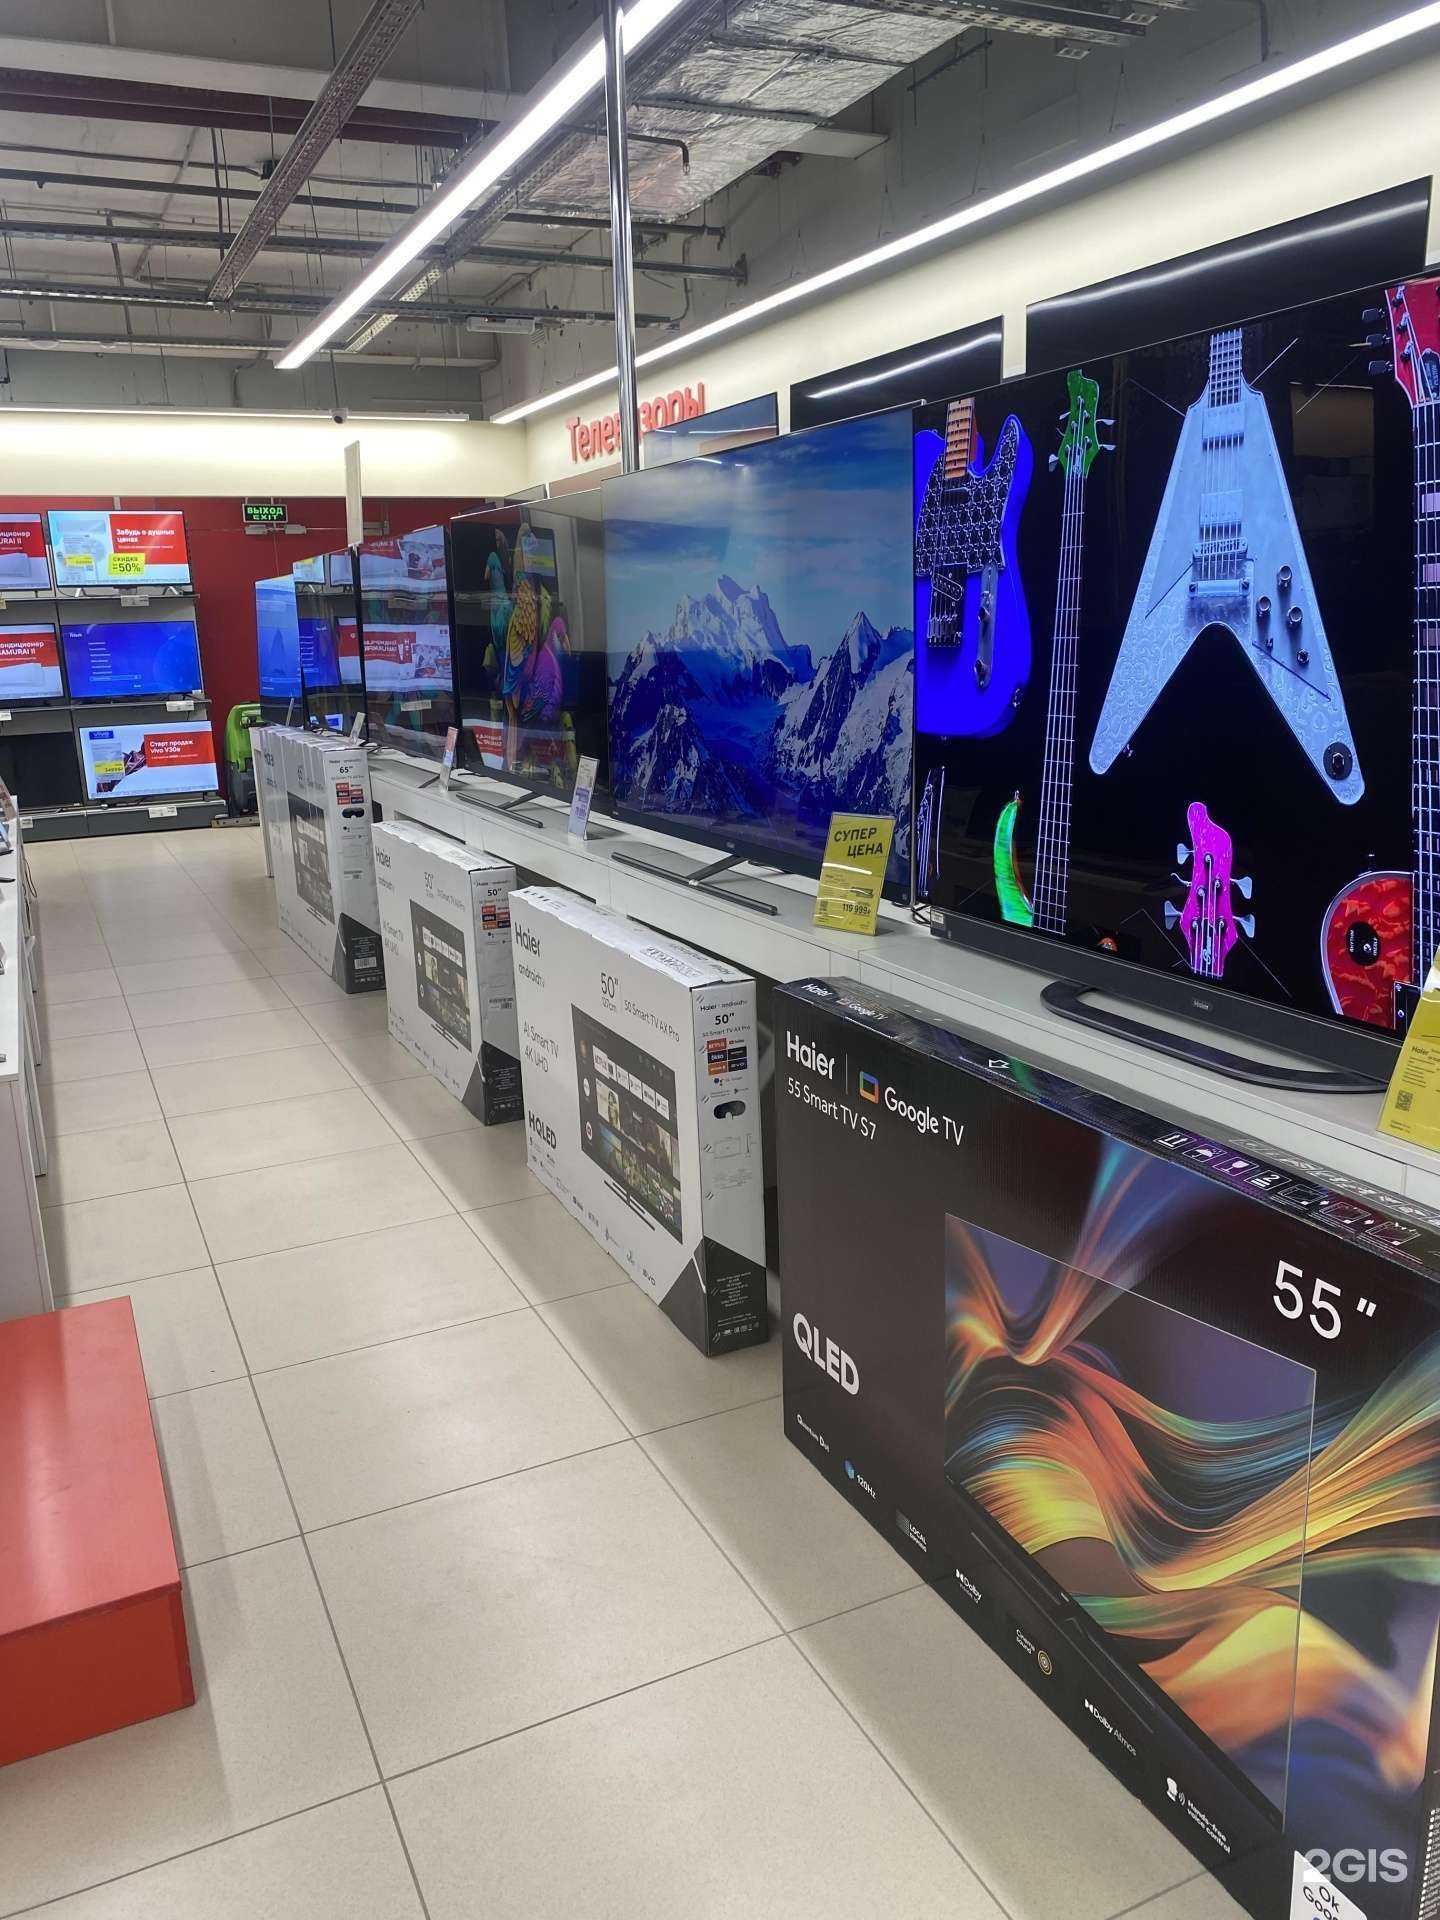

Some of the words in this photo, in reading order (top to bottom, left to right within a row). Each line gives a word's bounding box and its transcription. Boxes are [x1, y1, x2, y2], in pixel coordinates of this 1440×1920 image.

[565, 382, 705, 463] Телевзоры
[247, 506, 283, 515] ВЫХОД
[150, 740, 168, 748] Старт
[834, 827, 877, 842] СУПЕР
[847, 842, 884, 858] ЦЕНА
[515, 922, 541, 958] Haier
[600, 972, 619, 999] 50"
[801, 983, 834, 997] Haier
[669, 1025, 680, 1042] Pro
[715, 1013, 735, 1026] 50"
[786, 1030, 836, 1080] Haier
[787, 1076, 801, 1099] 55
[803, 1084, 839, 1121] Smart
[840, 1104, 859, 1130] TV
[860, 1115, 877, 1141] S7
[884, 1086, 939, 1134] Google
[942, 1115, 965, 1146] TV
[528, 1109, 557, 1149] HQLED
[1272, 1259, 1378, 1340] 55"
[793, 1312, 860, 1396] QLED
[856, 1474, 877, 1500] 120Hz
[909, 1523, 927, 1546] LOCAL
[963, 1576, 982, 1601] Dolby
[1093, 1707, 1114, 1733] Dolby
[1113, 1729, 1137, 1757] Atmos
[1187, 1799, 1227, 1842] Hands-free
[1187, 1808, 1206, 1829] voice
[1206, 1826, 1231, 1856] control
[1319, 1885, 1340, 1913] Ok
